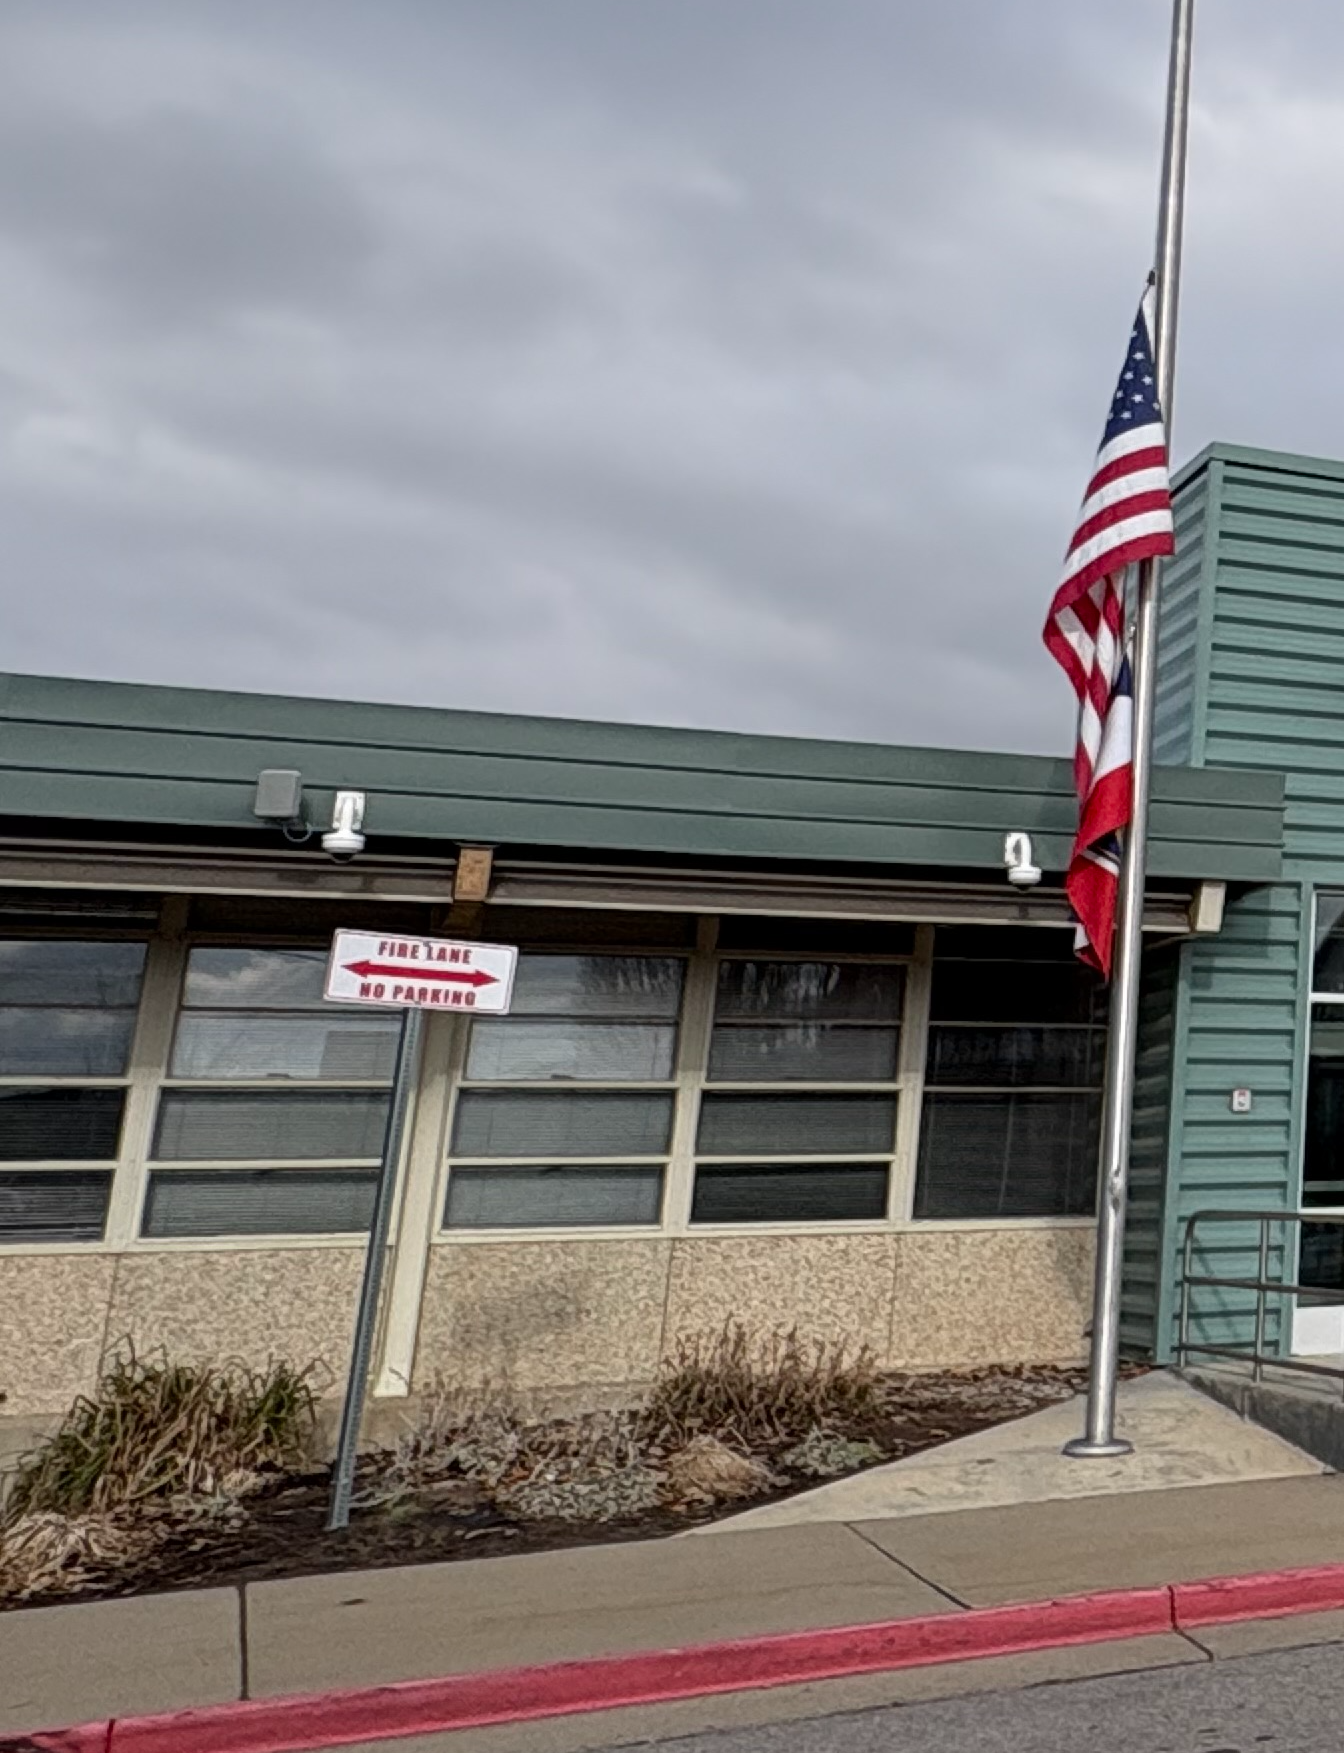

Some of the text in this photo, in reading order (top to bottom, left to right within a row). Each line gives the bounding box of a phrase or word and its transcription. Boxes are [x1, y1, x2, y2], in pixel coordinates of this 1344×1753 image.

[378, 941, 473, 964] FIRE LANE
[359, 982, 477, 1006] NO PARKING
